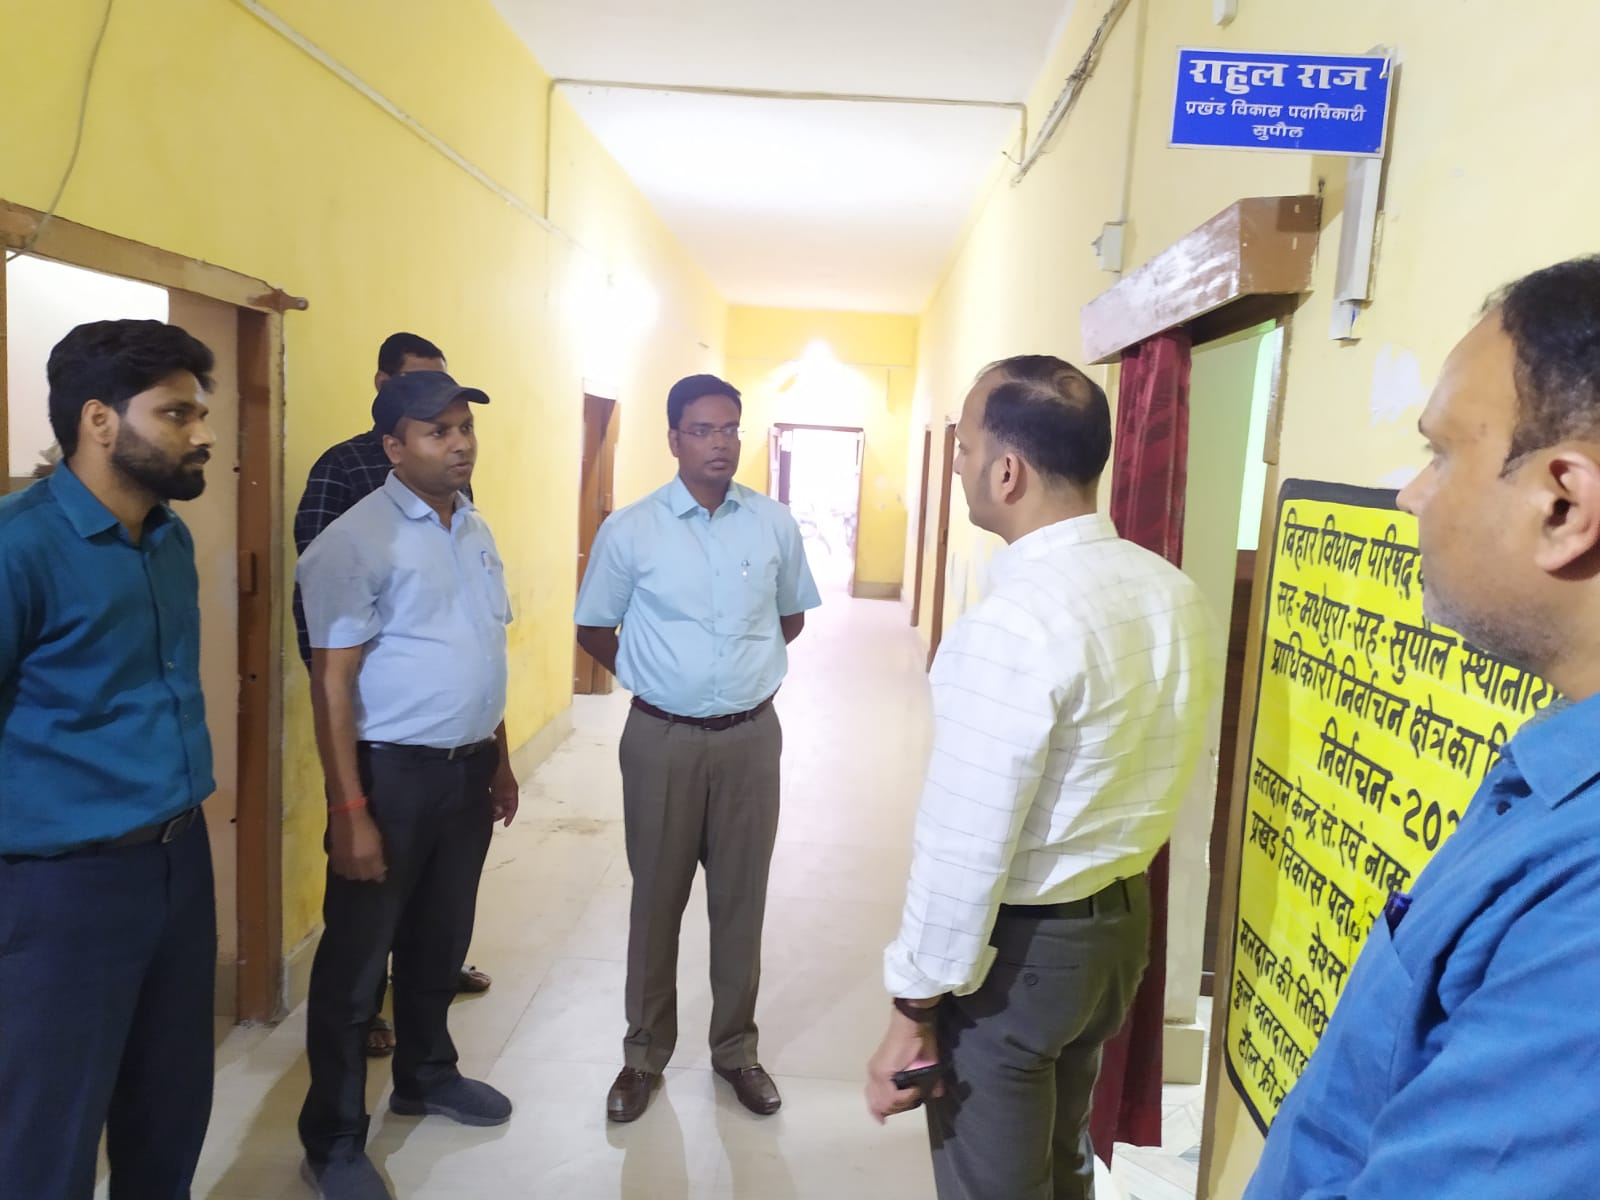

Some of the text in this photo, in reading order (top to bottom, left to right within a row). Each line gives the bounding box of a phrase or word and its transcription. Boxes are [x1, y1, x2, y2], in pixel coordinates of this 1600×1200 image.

[1185, 97, 1367, 122] प्रखंड विकास पदाधिकारी
[1189, 60, 1372, 95] राहुल राज
[1251, 121, 1304, 141] सुपौल
[1281, 507, 1319, 572] बिहार
[1317, 514, 1367, 577] विधान
[1271, 631, 1337, 701] प्राधिकारी
[1335, 654, 1410, 737] निर्वाचन
[1409, 693, 1453, 761] क्षेत्र
[1448, 725, 1485, 779] का
[1253, 758, 1294, 813] मतदान
[1292, 775, 1321, 840] केन्द्र
[1250, 811, 1280, 861] प्रखंड
[1279, 826, 1327, 907] विकास
[1235, 969, 1256, 1014] कुल
[1241, 918, 1278, 985] मतदान
[1276, 956, 1294, 1003] की
